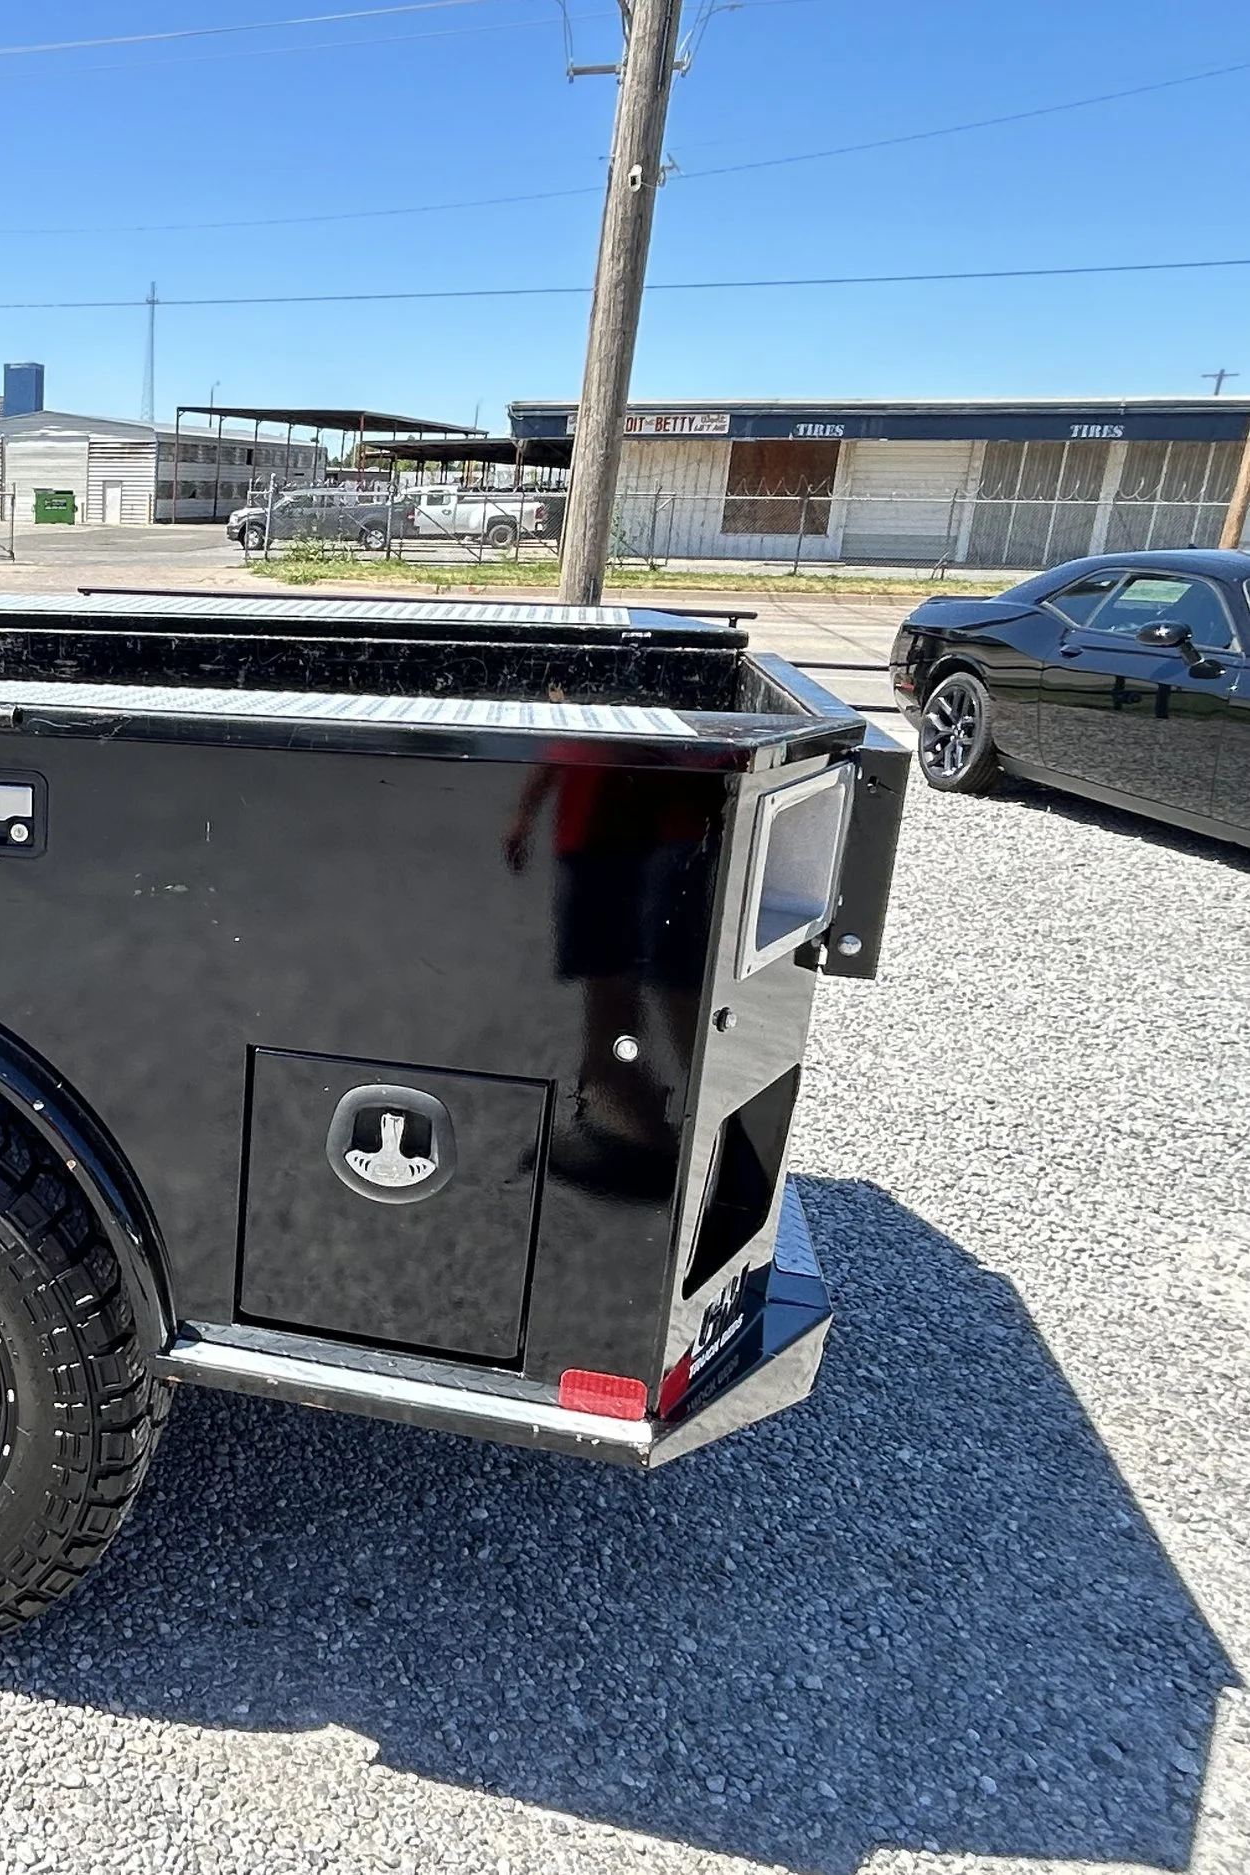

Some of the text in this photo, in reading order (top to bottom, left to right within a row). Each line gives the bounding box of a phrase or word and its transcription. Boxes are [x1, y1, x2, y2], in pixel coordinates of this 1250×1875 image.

[654, 416, 696, 433] BETTY
[796, 423, 845, 437] TIRES
[1070, 424, 1125, 438] TIRES
